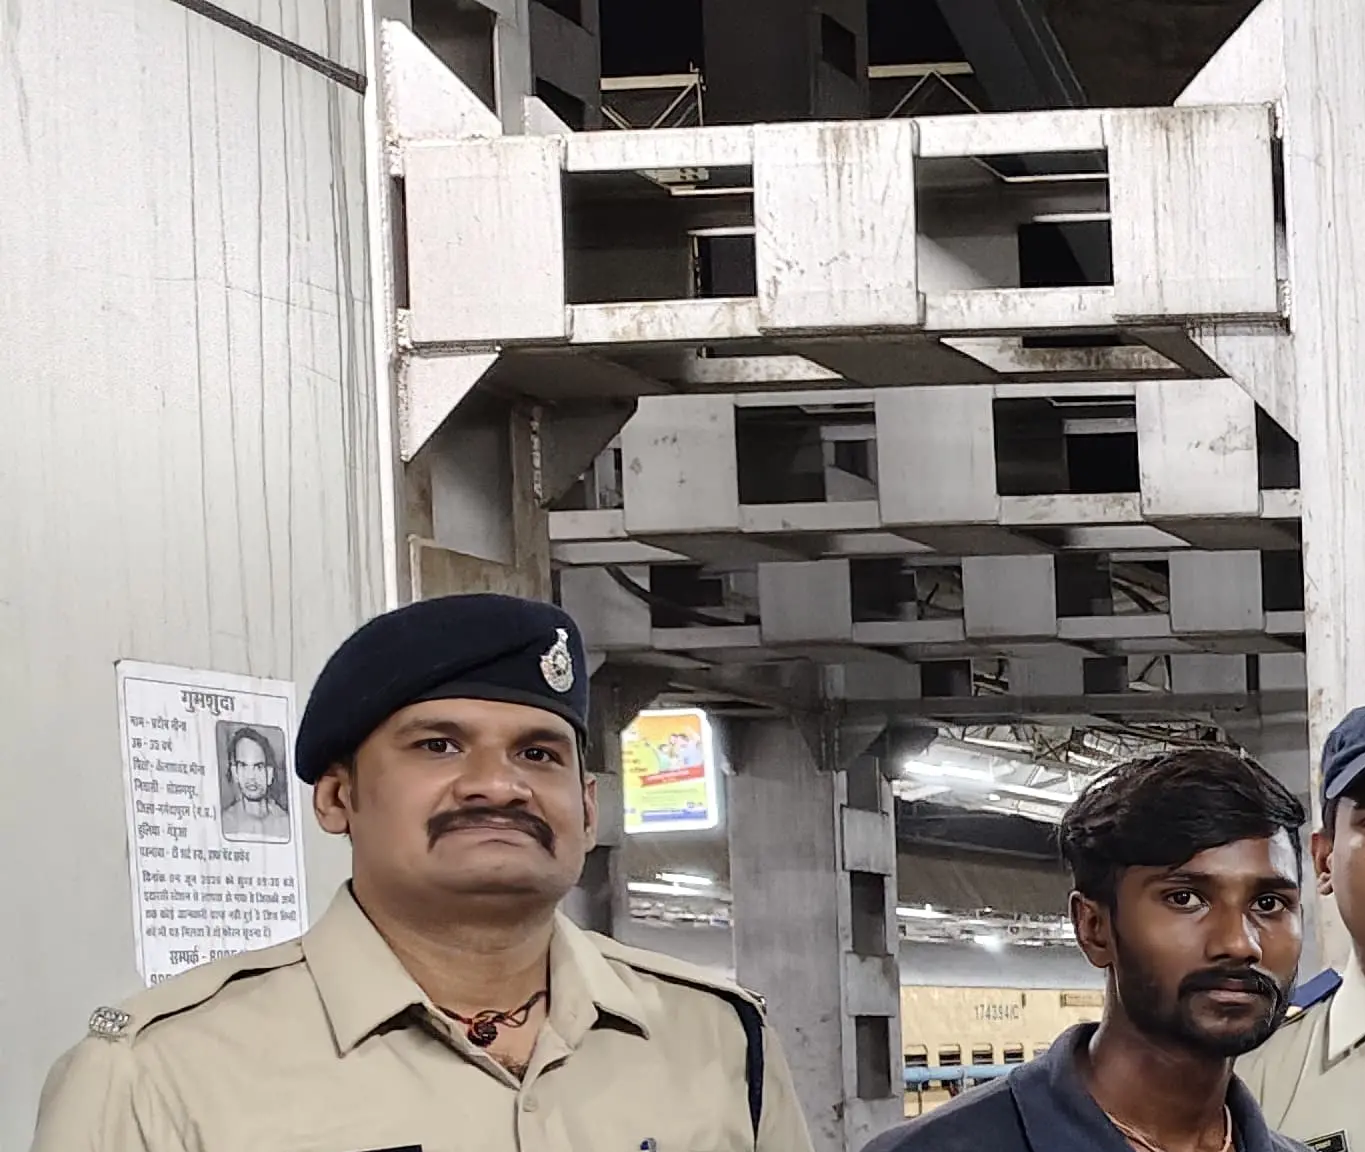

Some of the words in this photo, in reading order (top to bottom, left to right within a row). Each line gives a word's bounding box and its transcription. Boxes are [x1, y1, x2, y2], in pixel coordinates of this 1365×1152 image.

[180, 690, 235, 716] गुमशुदा
[130, 716, 144, 727] नाम
[169, 944, 199, 965] सम्पर्क
